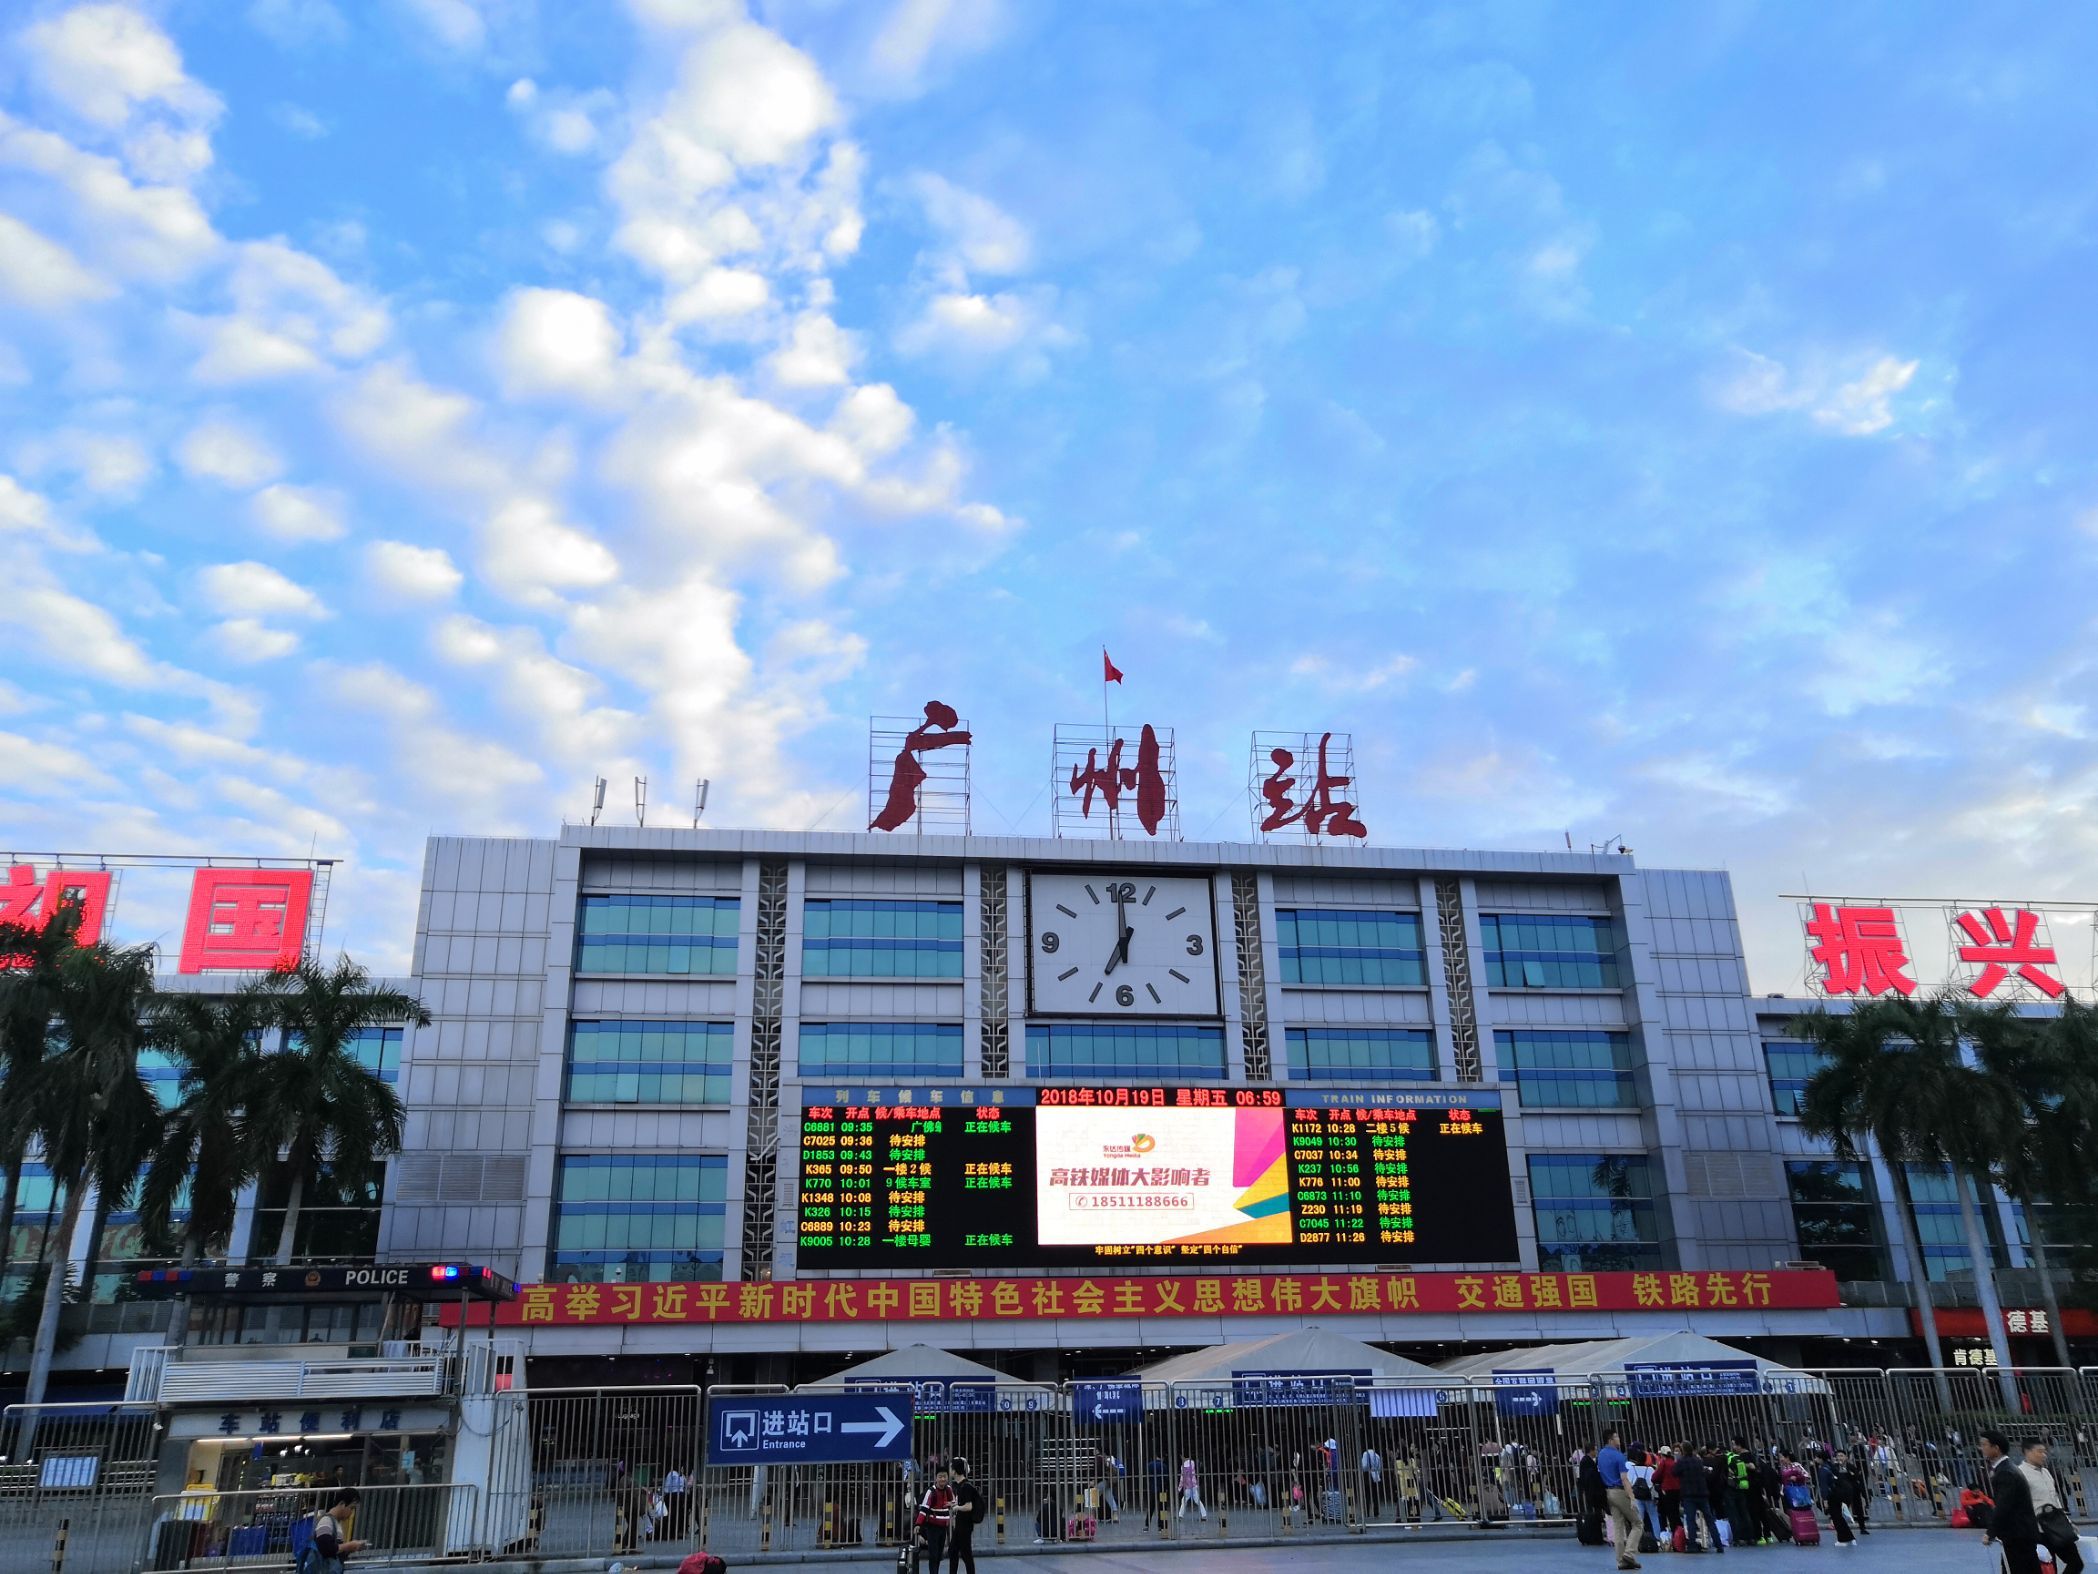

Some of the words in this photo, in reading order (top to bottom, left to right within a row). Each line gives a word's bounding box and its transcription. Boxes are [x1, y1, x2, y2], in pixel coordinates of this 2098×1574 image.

[869, 700, 1367, 838] 广州站
[1106, 882, 1137, 904] 12
[1041, 932, 1060, 953] 9
[1186, 935, 1204, 955] 3
[1806, 903, 2066, 998] 振兴
[1115, 986, 1134, 1007] 6
[1041, 1089, 1164, 1106] 2018年10月19日
[1176, 1089, 1227, 1106] 星期五
[1236, 1091, 1280, 1105] 06:59
[1321, 1094, 1364, 1103] TRAIN
[1372, 1095, 1467, 1104] INFORMATION
[809, 1107, 833, 1120] 车次
[846, 1107, 869, 1120] 开点
[976, 1107, 1000, 1120] 状态
[1295, 1109, 1318, 1120] 车次
[1329, 1109, 1351, 1120] 开点
[1449, 1110, 1470, 1120] 状态
[804, 1123, 834, 1132] C6881
[841, 1123, 872, 1132] 09:35
[965, 1121, 1011, 1133] 正在候车
[1292, 1124, 1321, 1133] K1172
[1327, 1124, 1355, 1133] 10:28
[1440, 1123, 1483, 1134] 正在候车
[804, 1137, 835, 1146] C7025
[841, 1137, 872, 1146] 09:36
[889, 1135, 925, 1147] 待安排
[1294, 1137, 1322, 1146] K9049
[1328, 1137, 1356, 1146] 10:30
[1372, 1136, 1405, 1147] 待安排
[803, 1151, 834, 1160] D1853
[840, 1151, 872, 1160] 09:43
[889, 1149, 925, 1161] 待安排
[1295, 1151, 1323, 1159] C7037
[1329, 1151, 1358, 1159] 10:34
[1373, 1149, 1406, 1161] 待安排
[806, 1165, 831, 1174] K365
[840, 1165, 872, 1174] 09:50
[965, 1163, 1012, 1176] 正在候车
[1299, 1164, 1321, 1173] K237
[1331, 1164, 1359, 1173] 10:56
[1375, 1163, 1408, 1174] 待安排
[806, 1179, 831, 1188] K770
[841, 1179, 870, 1188] 10:01
[965, 1177, 1012, 1189] 正在候车
[1050, 1168, 1211, 1186] 高铁媒体大影响者
[1332, 1178, 1360, 1186] 11:00
[1376, 1176, 1409, 1187] 待安排
[802, 1193, 834, 1202] K1348
[840, 1193, 871, 1202] 10:08
[889, 1191, 925, 1204] 待安排
[1298, 1191, 1326, 1200] C6873
[1333, 1191, 1361, 1200] 11:10
[1377, 1189, 1410, 1201] 待安排
[1092, 1197, 1188, 1207] 18511188666
[805, 1207, 830, 1217] K326
[840, 1207, 871, 1217] 10:15
[889, 1205, 925, 1218] 待安排
[1301, 1205, 1325, 1214] Z230
[1334, 1205, 1363, 1214] 11:19
[1378, 1203, 1412, 1215] 待安排
[801, 1222, 833, 1231] C6889
[840, 1222, 871, 1231] 10:23
[889, 1220, 925, 1232] 待安排
[1300, 1219, 1329, 1228] C7045
[1335, 1219, 1363, 1228] 11:22
[1380, 1217, 1413, 1229] 待安排
[800, 1237, 833, 1246] K9005
[840, 1237, 870, 1246] 10:28
[965, 1235, 1013, 1246] 正在候车
[1300, 1233, 1329, 1242] D2877
[1336, 1233, 1365, 1242] 11:26
[1381, 1231, 1415, 1243] 待安排
[225, 1272, 277, 1288] 警察
[345, 1270, 409, 1286] POLICE
[521, 1275, 1420, 1321] 高举习近平新时代中国特色社会主义思想伟大旗帜
[1455, 1274, 1598, 1309] 交通强国
[1632, 1272, 1772, 1307] 铁路先行
[2007, 1310, 2049, 1333] 德基
[1953, 1349, 1998, 1366] 肯德基
[1618, 1387, 1624, 1395] 3
[218, 1408, 401, 1435] 车站便利店
[762, 1410, 832, 1436] 进站口
[762, 1440, 806, 1450] Entrance
